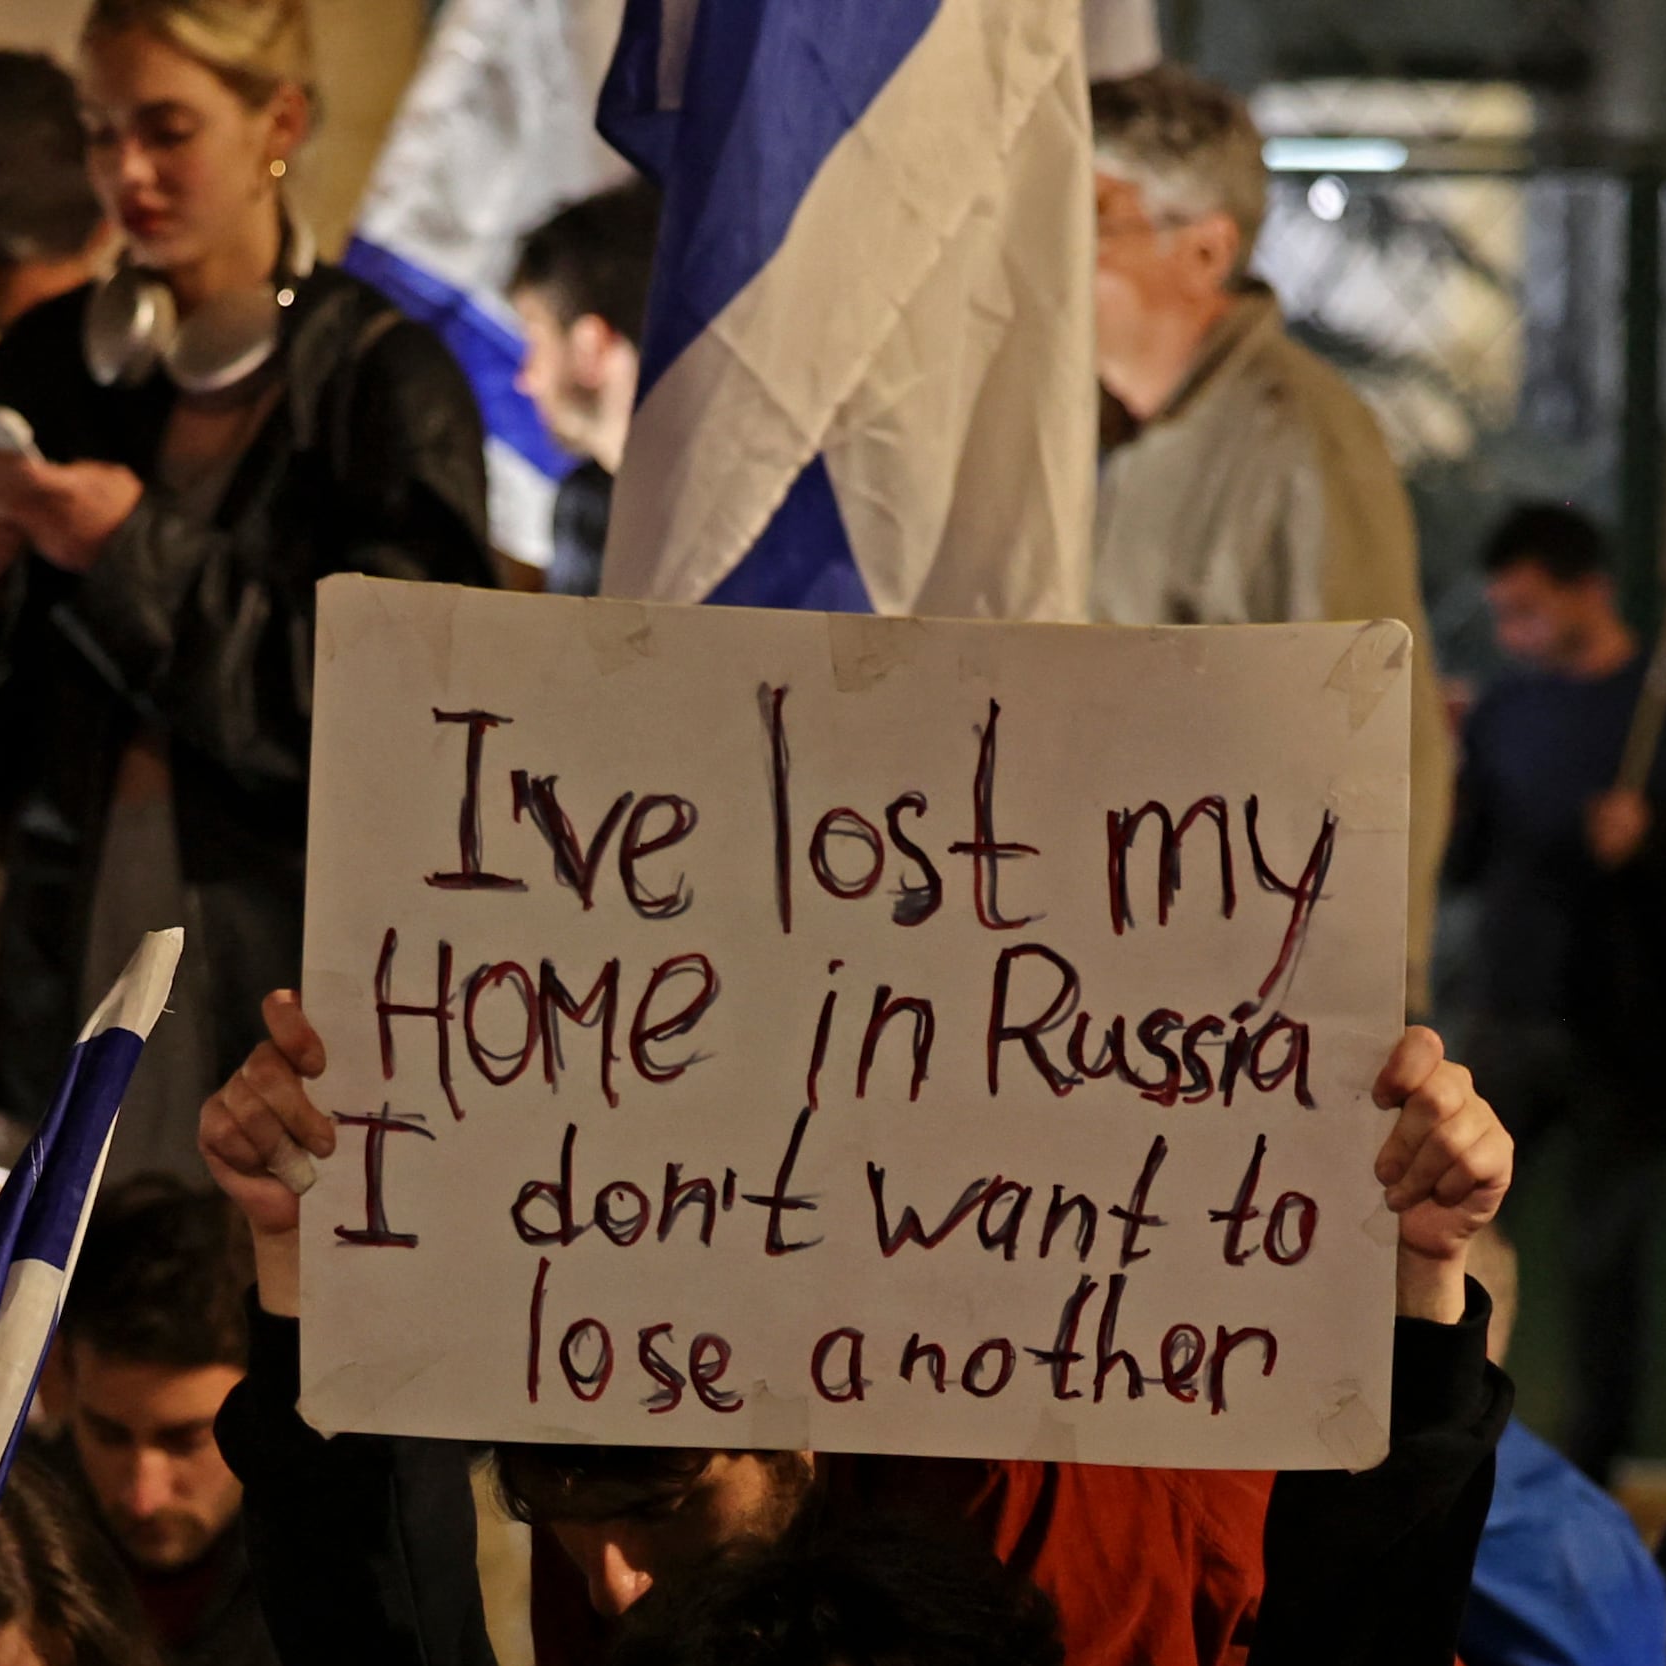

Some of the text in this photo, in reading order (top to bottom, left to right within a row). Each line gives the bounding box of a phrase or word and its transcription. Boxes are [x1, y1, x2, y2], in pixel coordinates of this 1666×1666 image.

[425, 682, 1338, 1000] I've lost my
[807, 960, 935, 1110] in
[987, 943, 1315, 1108] Russia
[333, 1103, 1317, 1268] I don't want to
[527, 1259, 1278, 1415] lose another
